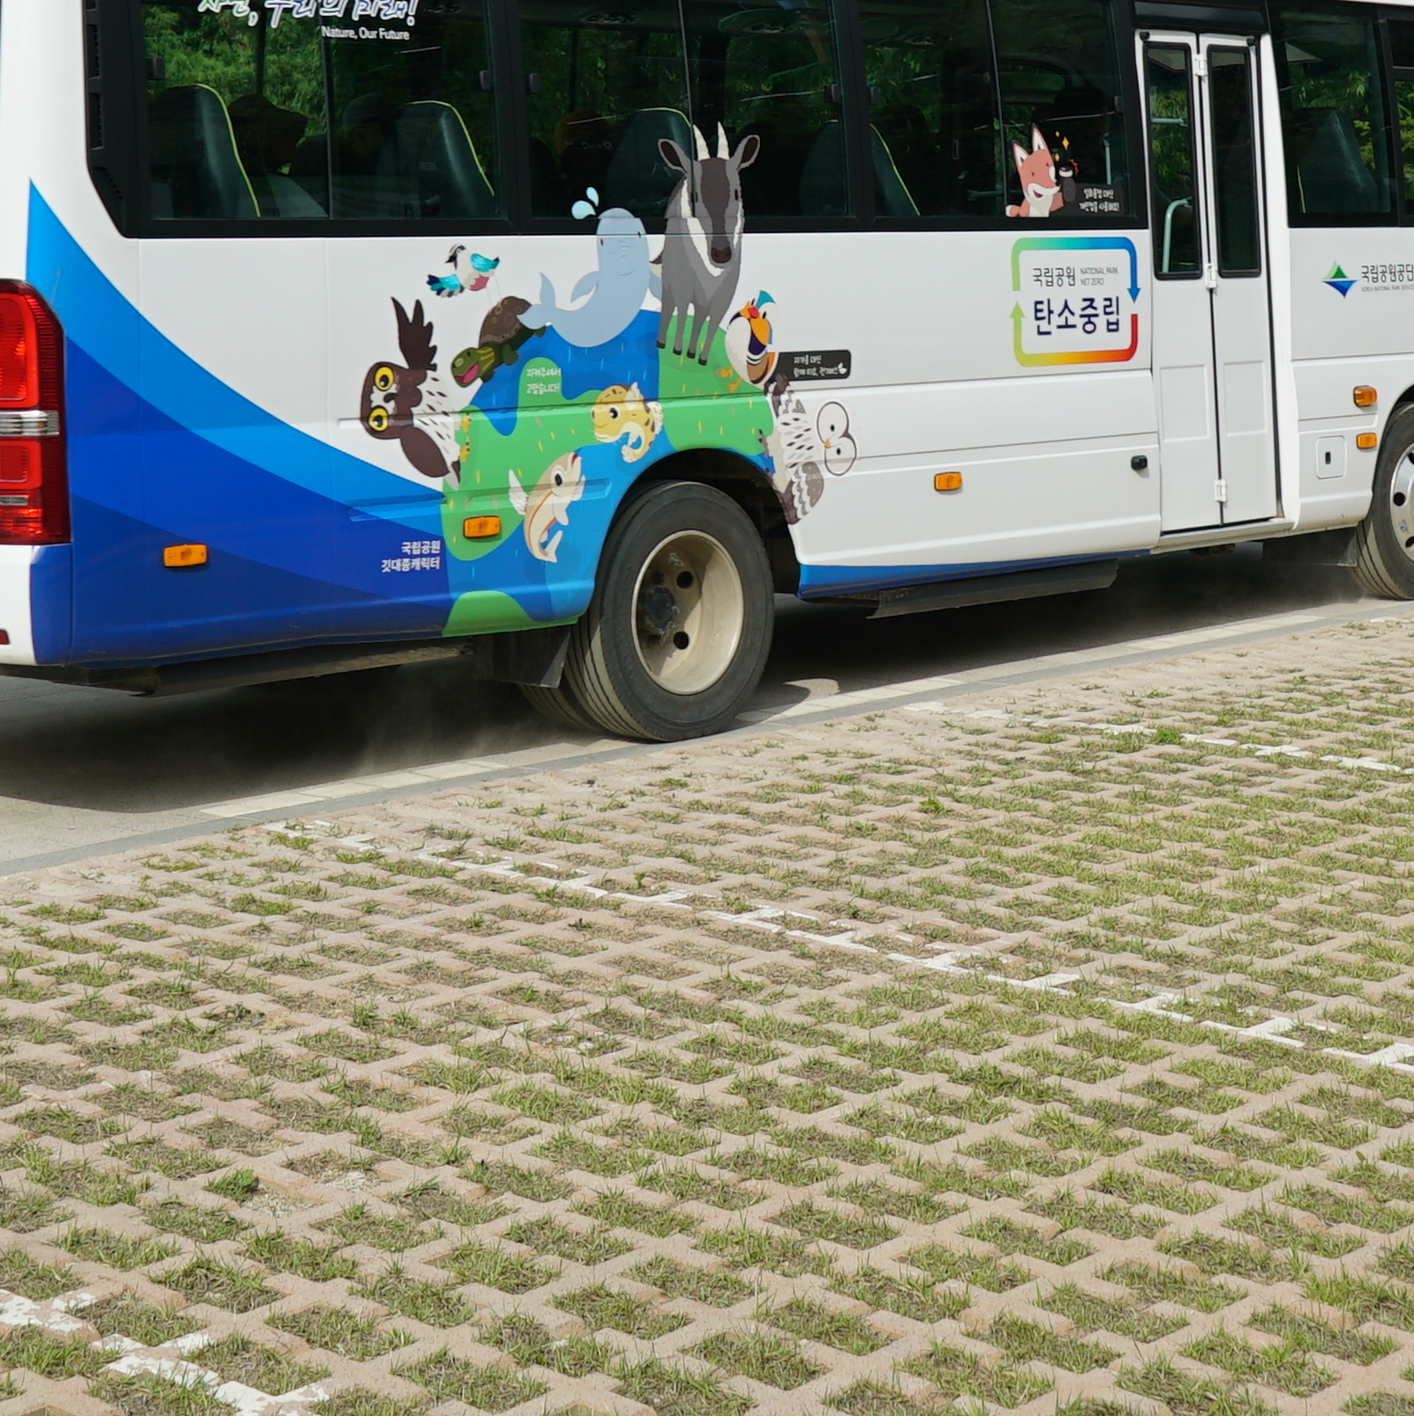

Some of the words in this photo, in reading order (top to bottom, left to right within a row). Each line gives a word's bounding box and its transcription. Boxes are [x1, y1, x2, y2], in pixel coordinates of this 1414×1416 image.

[321, 25, 358, 40] Nature,
[359, 27, 378, 40] Our
[378, 27, 410, 41] Future
[1032, 266, 1076, 288] 국립공원
[1080, 266, 1105, 275] NATIONAL
[1106, 266, 1119, 274] PARK
[1360, 263, 1414, 284] 국립공원공단
[1080, 278, 1090, 286] NET
[1091, 277, 1105, 286] ZERO
[1033, 295, 1120, 336] 탄소중립
[400, 539, 441, 555] 국립공원
